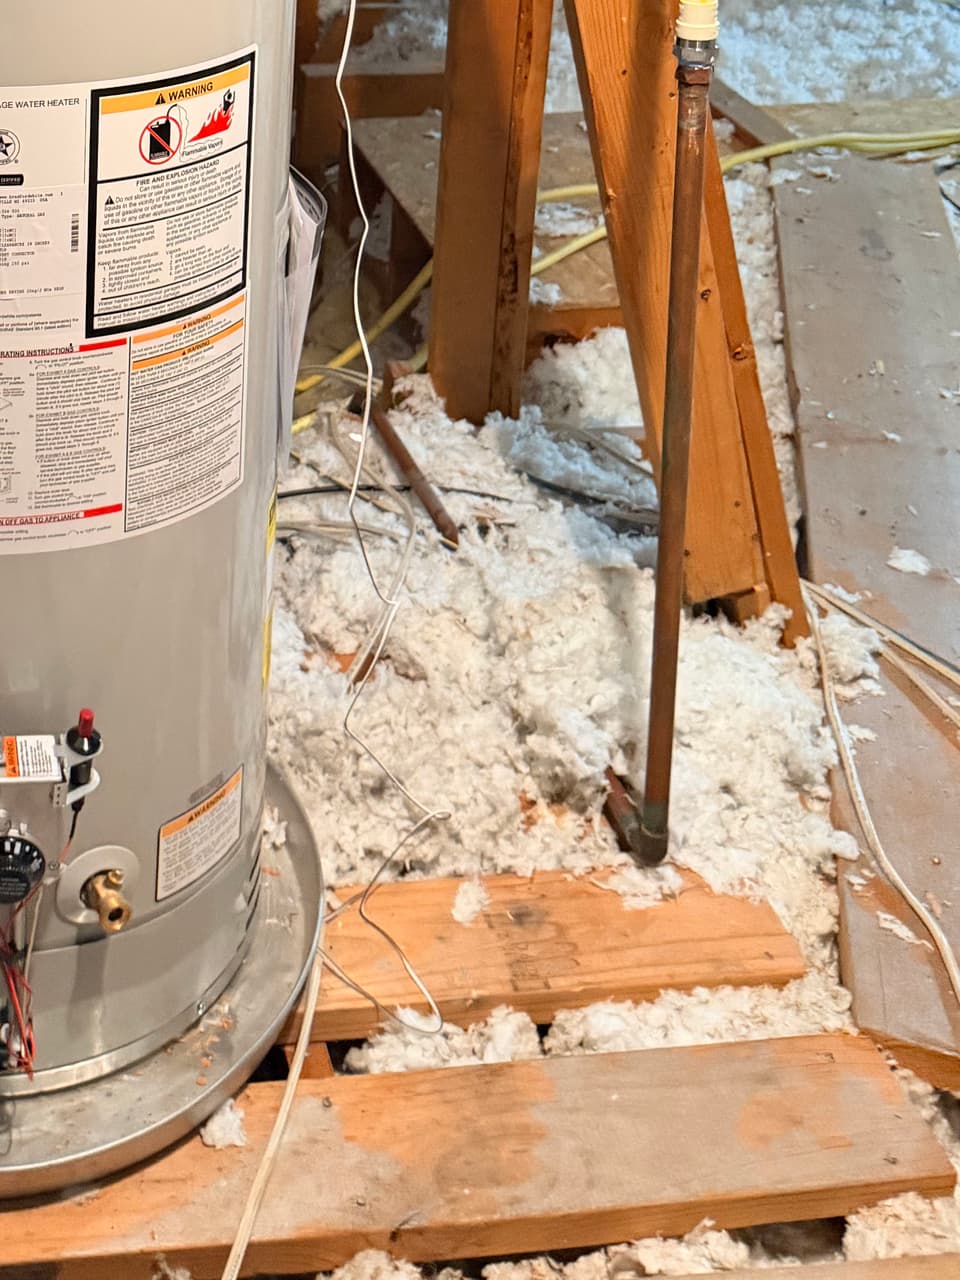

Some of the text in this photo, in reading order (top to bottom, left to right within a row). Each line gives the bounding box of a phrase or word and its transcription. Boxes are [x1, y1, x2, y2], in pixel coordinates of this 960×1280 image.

[169, 82, 213, 101] WARNING
[15, 100, 46, 108] WATER
[47, 98, 80, 106] HEATER
[166, 167, 197, 180] EXPLOSION
[199, 159, 219, 171] HAZARD
[27, 347, 74, 357] INSTRUCTIONS
[45, 512, 80, 522] APPLIANCE
